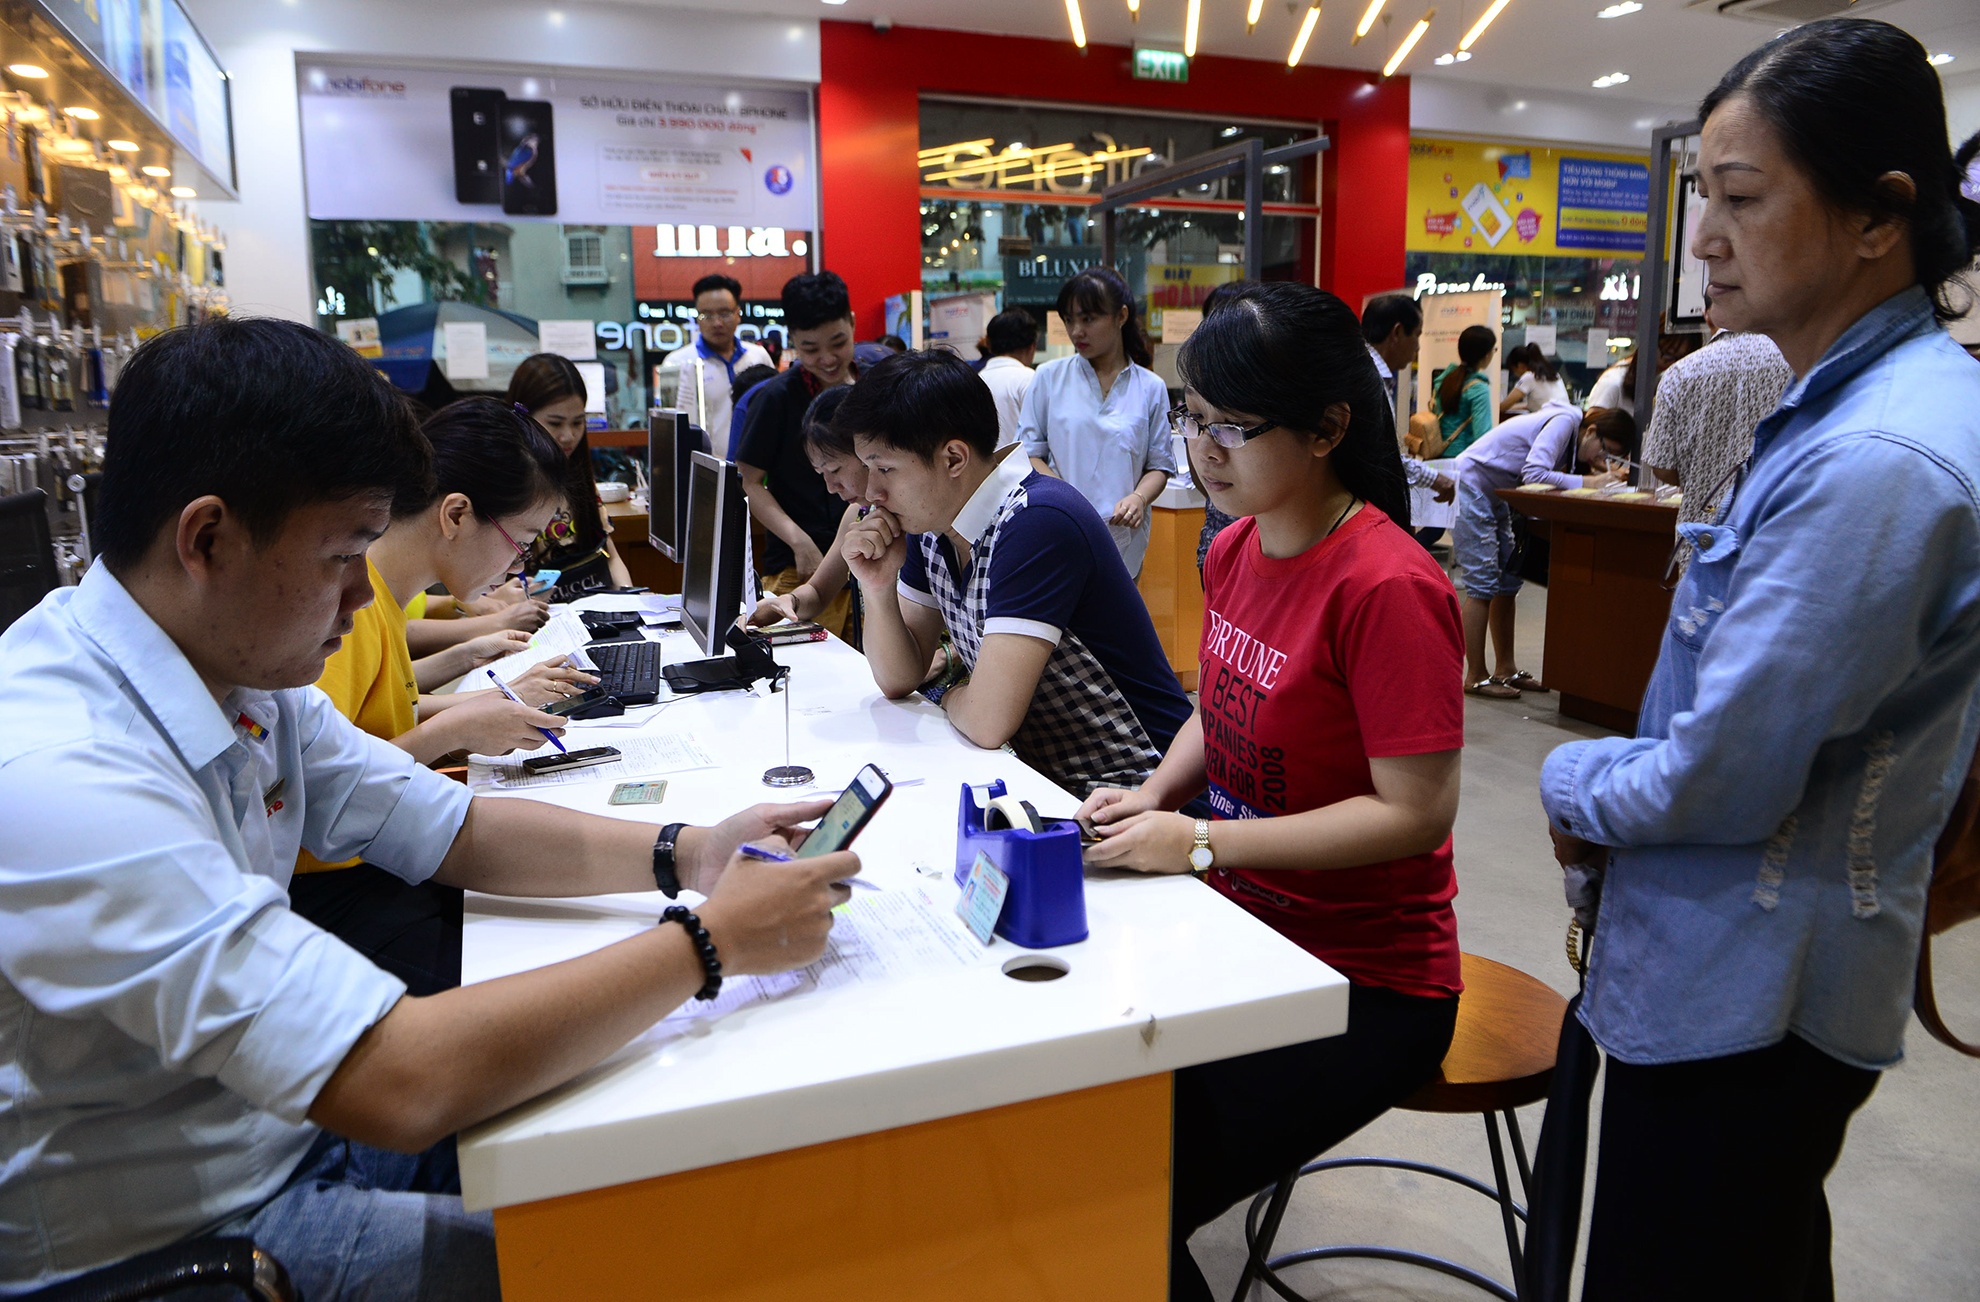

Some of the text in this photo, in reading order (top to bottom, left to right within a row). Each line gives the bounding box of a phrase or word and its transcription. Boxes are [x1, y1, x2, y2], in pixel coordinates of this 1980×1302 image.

[322, 75, 406, 94] obifone
[1137, 50, 1184, 80] EXIT
[1212, 666, 1267, 735] BEST
[1229, 762, 1257, 801] FOR
[1261, 746, 1287, 811] 2008
